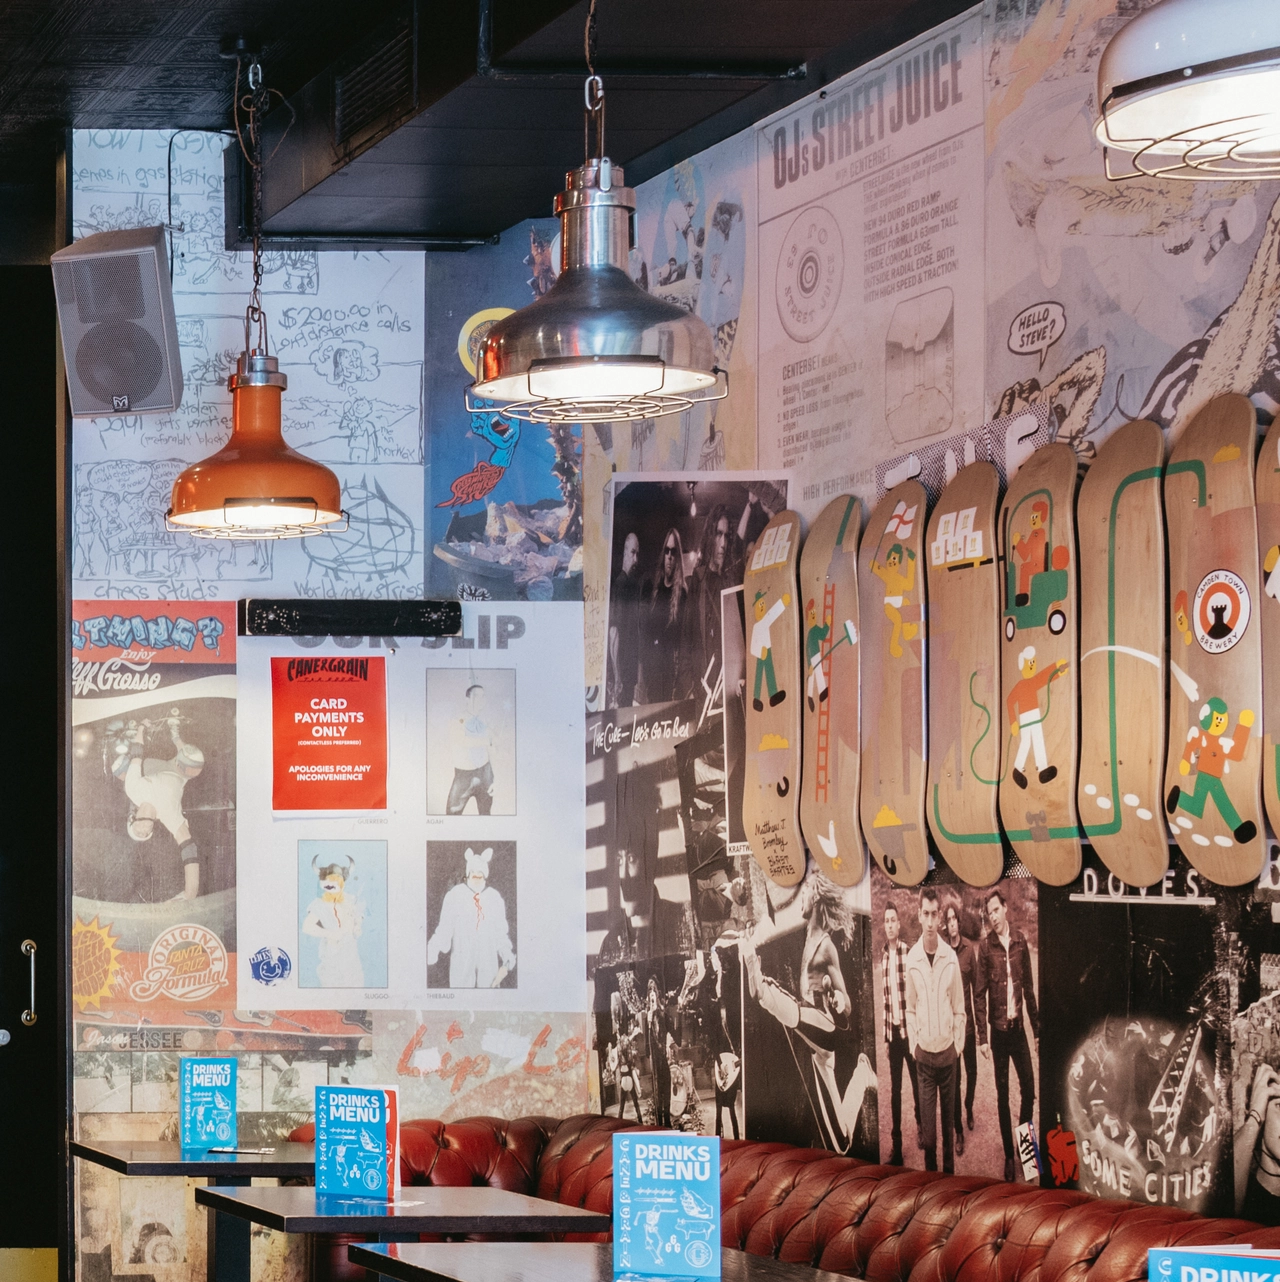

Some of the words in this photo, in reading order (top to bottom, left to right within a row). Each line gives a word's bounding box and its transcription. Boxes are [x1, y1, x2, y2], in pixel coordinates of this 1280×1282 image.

[812, 73, 887, 173] STREET
[890, 33, 964, 133] JUICE
[116, 164, 131, 186] in
[135, 166, 167, 189] gas
[906, 198, 920, 214] RED
[863, 228, 893, 248] FORMULA
[930, 197, 959, 221] ORANGE
[863, 245, 887, 263] STREET
[887, 230, 919, 250] FORMULA
[885, 248, 913, 268] CONICAL
[890, 260, 915, 280] RADIAL
[936, 245, 956, 262] BOTH
[896, 274, 917, 292] SPEED
[376, 301, 393, 315] in
[308, 319, 370, 342] distance
[377, 312, 412, 334] calls
[1018, 307, 1050, 332] HELLO
[1018, 318, 1056, 348] STEVE?
[782, 354, 821, 380] CENTERSET
[179, 399, 219, 415] stolen
[802, 485, 821, 501] HIGH
[822, 467, 876, 496] PERFORMANCE
[93, 580, 150, 601] chess
[157, 579, 220, 601] studs
[1196, 573, 1220, 598] CAMDEN
[1224, 574, 1245, 595] TOWN
[82, 614, 225, 653] THING?
[1199, 631, 1238, 650] BREWERY
[120, 648, 158, 661] Enjoy
[71, 656, 100, 697] eff
[97, 656, 162, 691] Grosso
[310, 698, 348, 709] CARD
[294, 711, 365, 723] PAYMENTS
[311, 725, 348, 738] ONLY
[288, 765, 335, 773] APOLOGIES
[335, 765, 353, 773] FOR
[353, 765, 372, 773] ANY
[296, 773, 363, 782] INCONVENIENCE
[754, 820, 780, 836] Matthew
[728, 844, 751, 853] KRAFTW
[1083, 867, 1200, 898] DOES
[153, 927, 223, 967] ORIGINAL
[166, 944, 203, 965] SANTA
[175, 956, 206, 976] CRUZ
[131, 966, 228, 1000] Formula
[119, 1031, 183, 1049] JESSEE
[192, 1063, 231, 1076] DRINKS
[192, 1074, 231, 1087] MENU
[329, 1093, 381, 1107] DRINKS
[329, 1105, 381, 1123] MENU
[635, 1144, 711, 1162] DRINKS
[635, 1160, 711, 1182] MENU
[1081, 1138, 1133, 1197] SOME
[1144, 1160, 1213, 1204] CITIES
